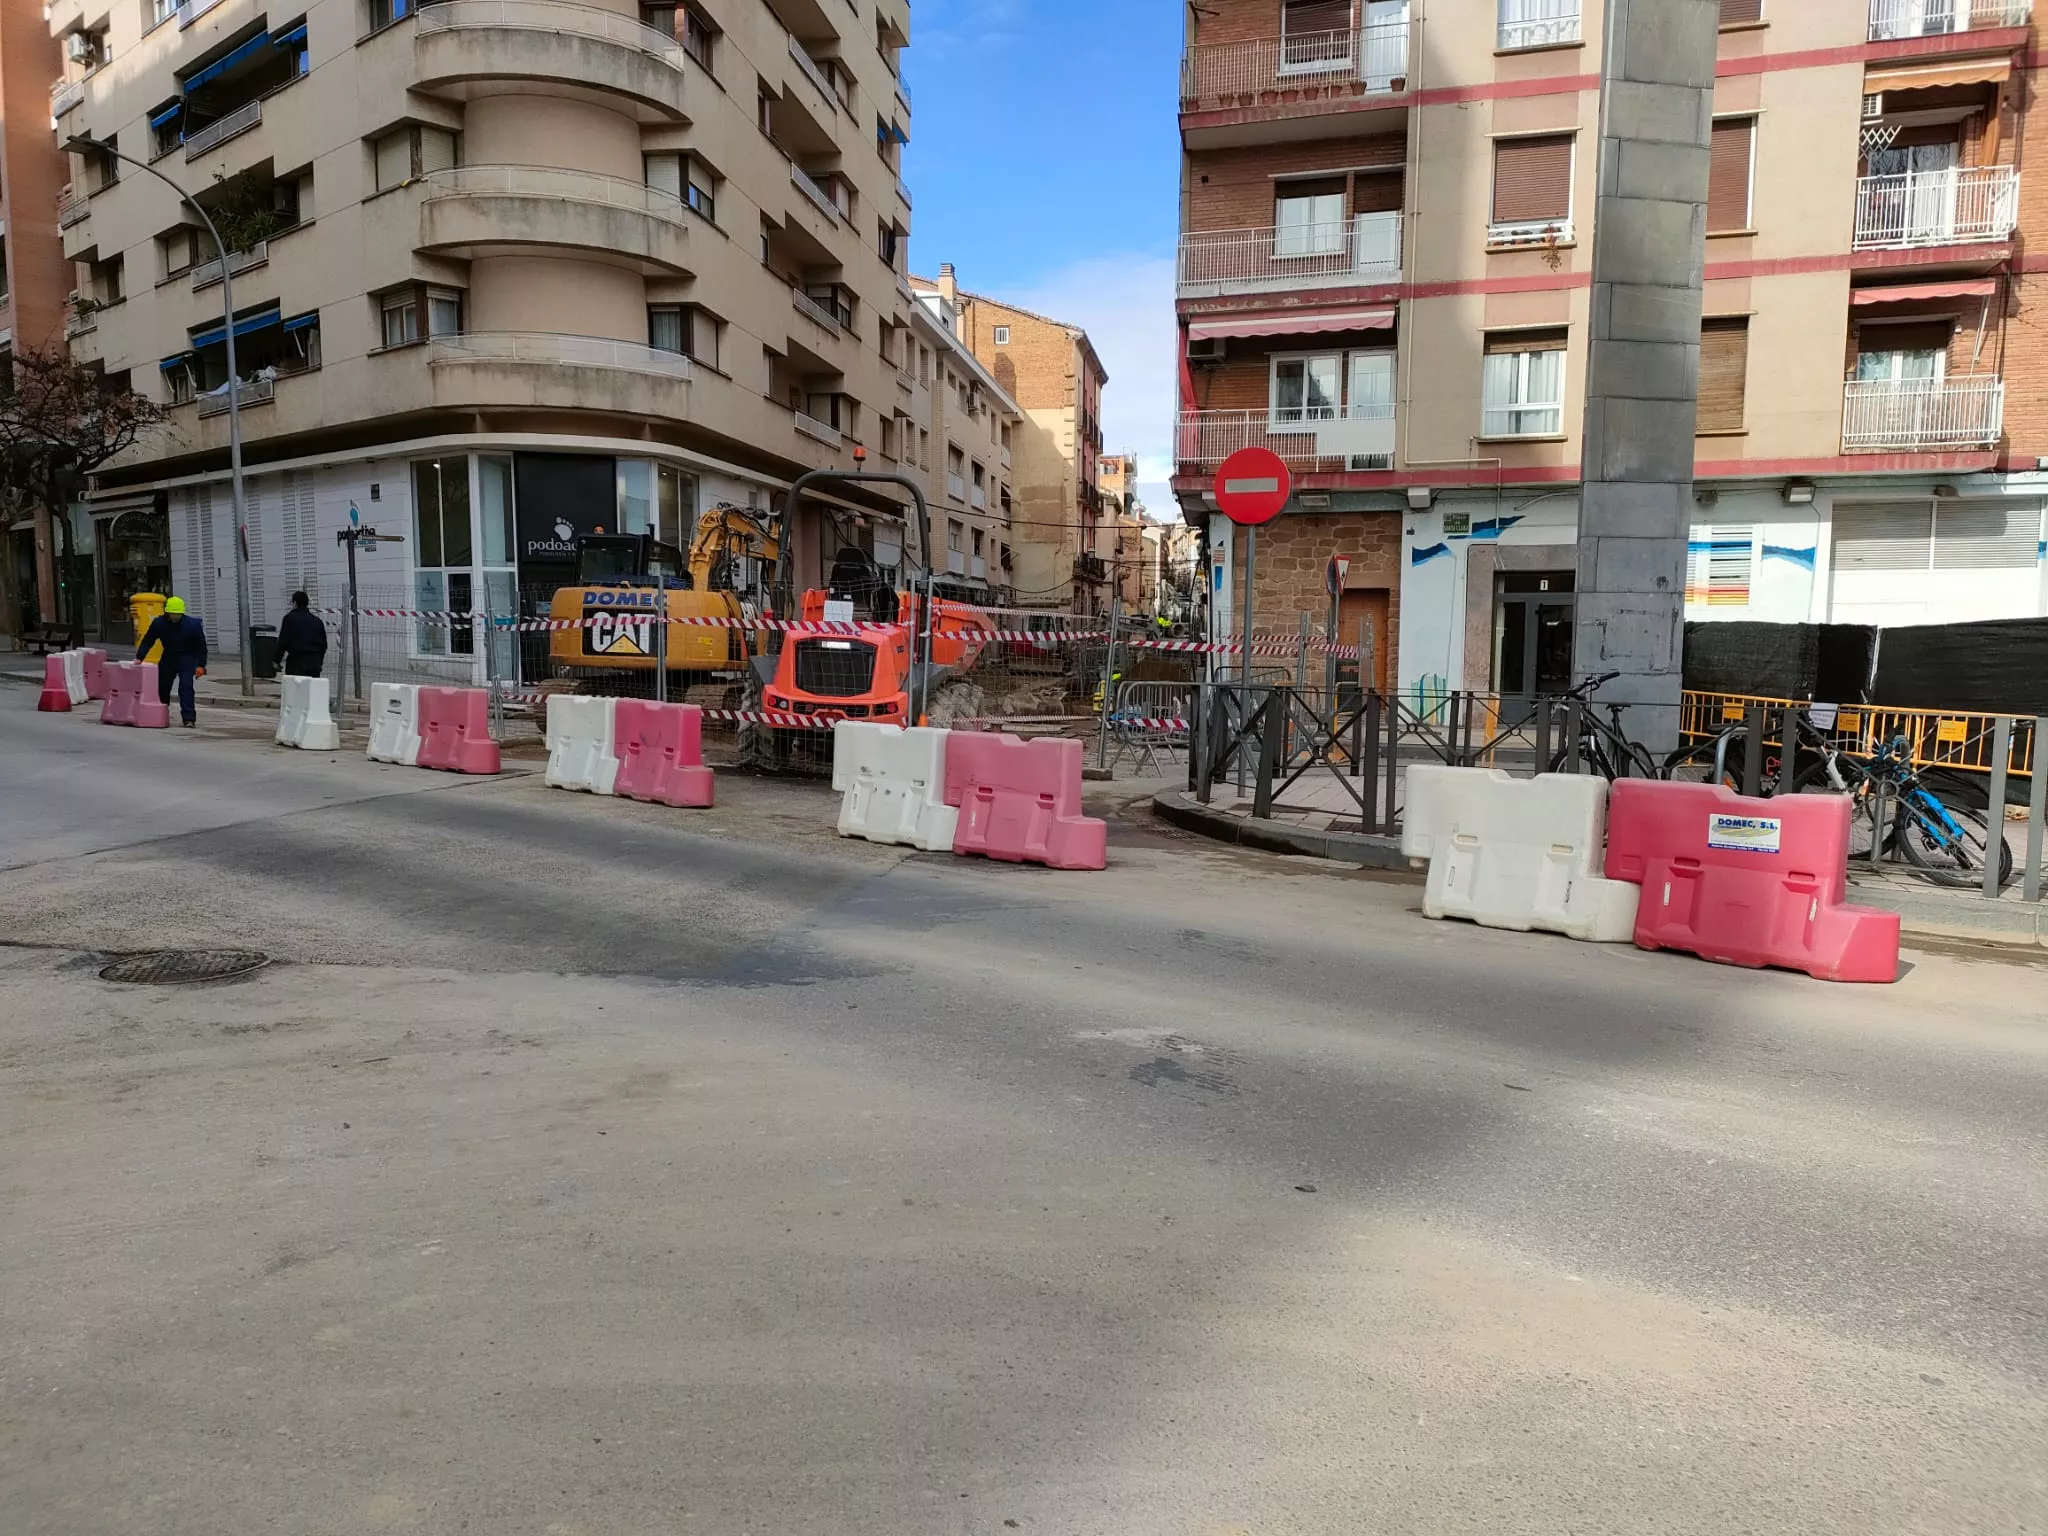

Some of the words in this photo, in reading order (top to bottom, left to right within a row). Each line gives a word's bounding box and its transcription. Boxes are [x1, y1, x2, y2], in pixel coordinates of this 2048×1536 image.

[528, 538, 577, 555] podoac
[592, 611, 656, 654] CAT
[1718, 818, 1756, 829] DOMEC,
[1760, 821, 1778, 830] S.L.
